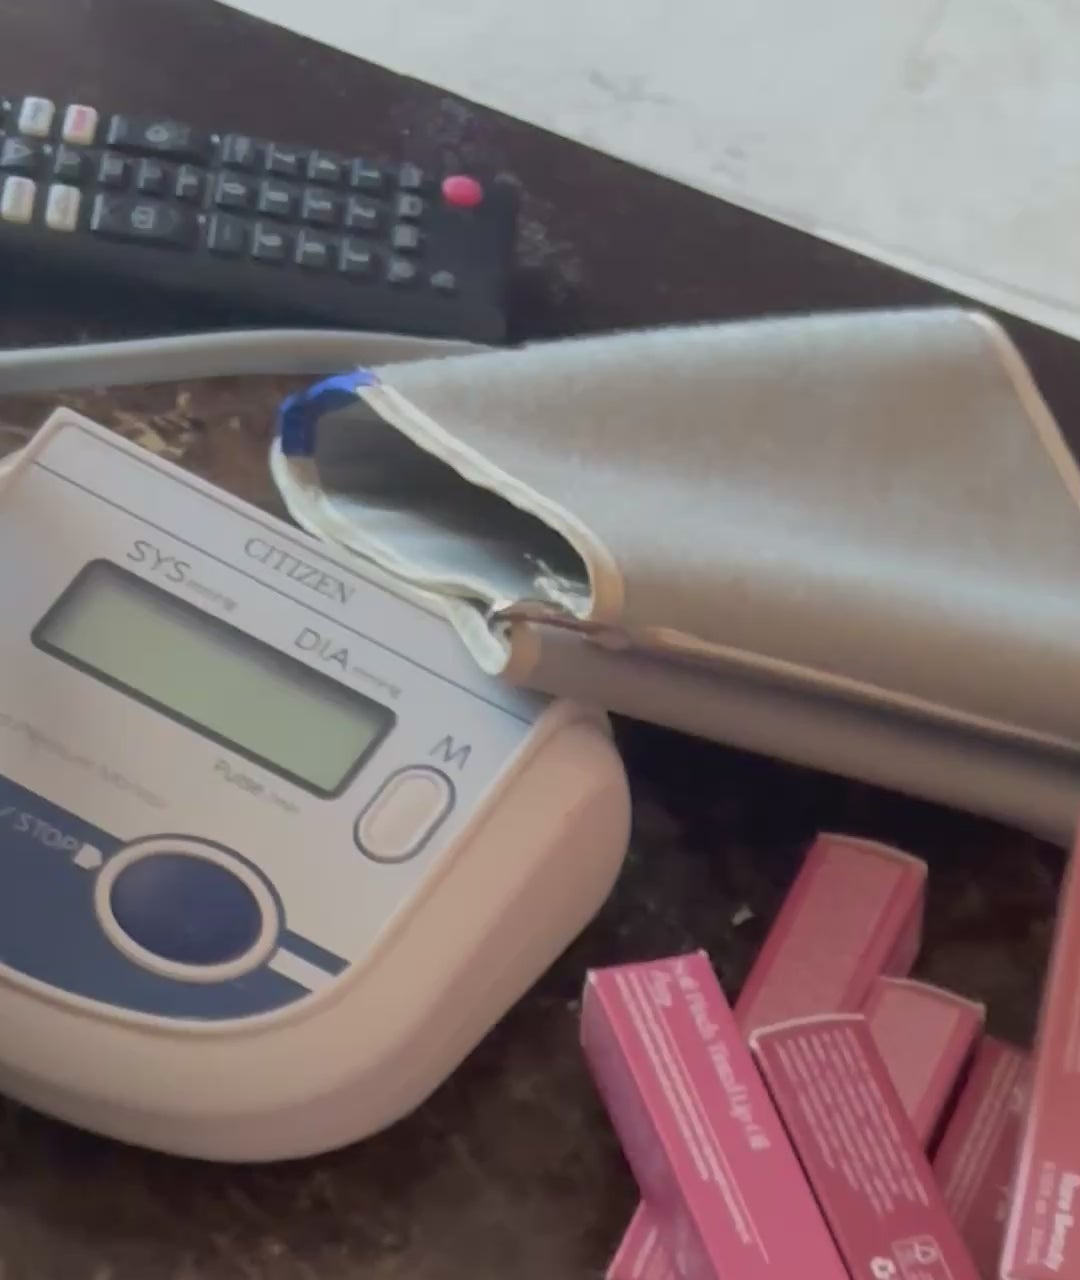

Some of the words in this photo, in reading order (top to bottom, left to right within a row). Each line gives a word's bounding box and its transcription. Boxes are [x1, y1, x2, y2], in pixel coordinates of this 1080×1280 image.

[127, 539, 191, 583] SYS
[243, 537, 356, 603] CITIZEN
[294, 627, 351, 671] DIA
[429, 734, 472, 771] M
